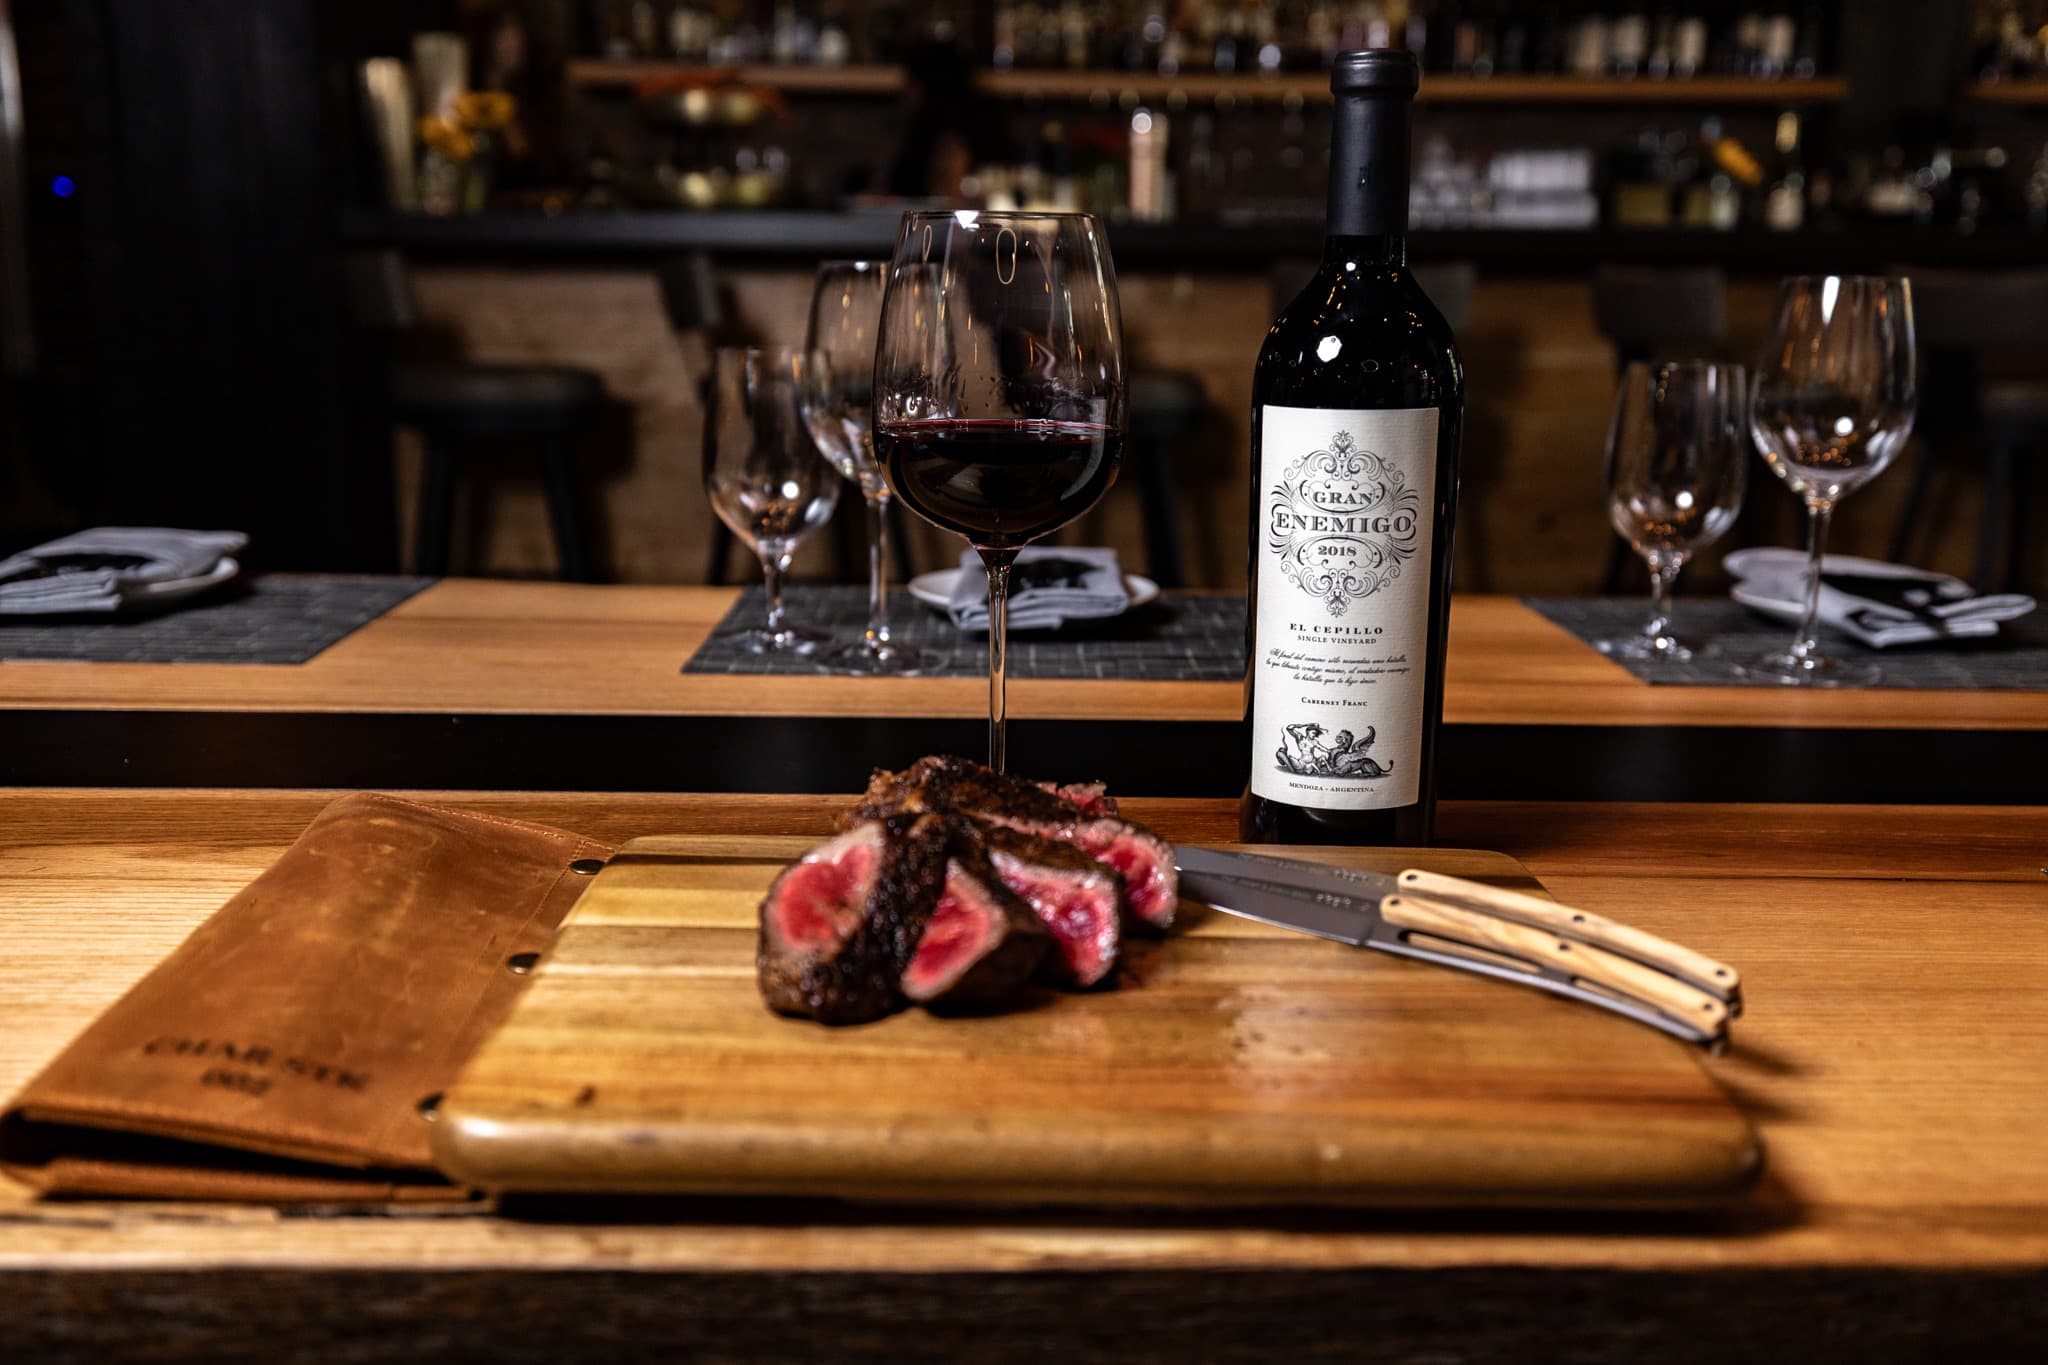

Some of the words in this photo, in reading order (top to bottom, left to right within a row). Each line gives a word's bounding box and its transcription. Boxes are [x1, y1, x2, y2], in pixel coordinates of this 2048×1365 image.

[1312, 490, 1374, 505] GRAN
[1275, 512, 1412, 534] ENEMIGO
[1318, 545, 1357, 557] 2018
[1290, 623, 1307, 632] EL
[1313, 625, 1383, 635] CEPILLO
[1297, 634, 1328, 643] SINGLE
[1331, 637, 1377, 645] VINEYARD
[1289, 781, 1324, 792] MENDOZA
